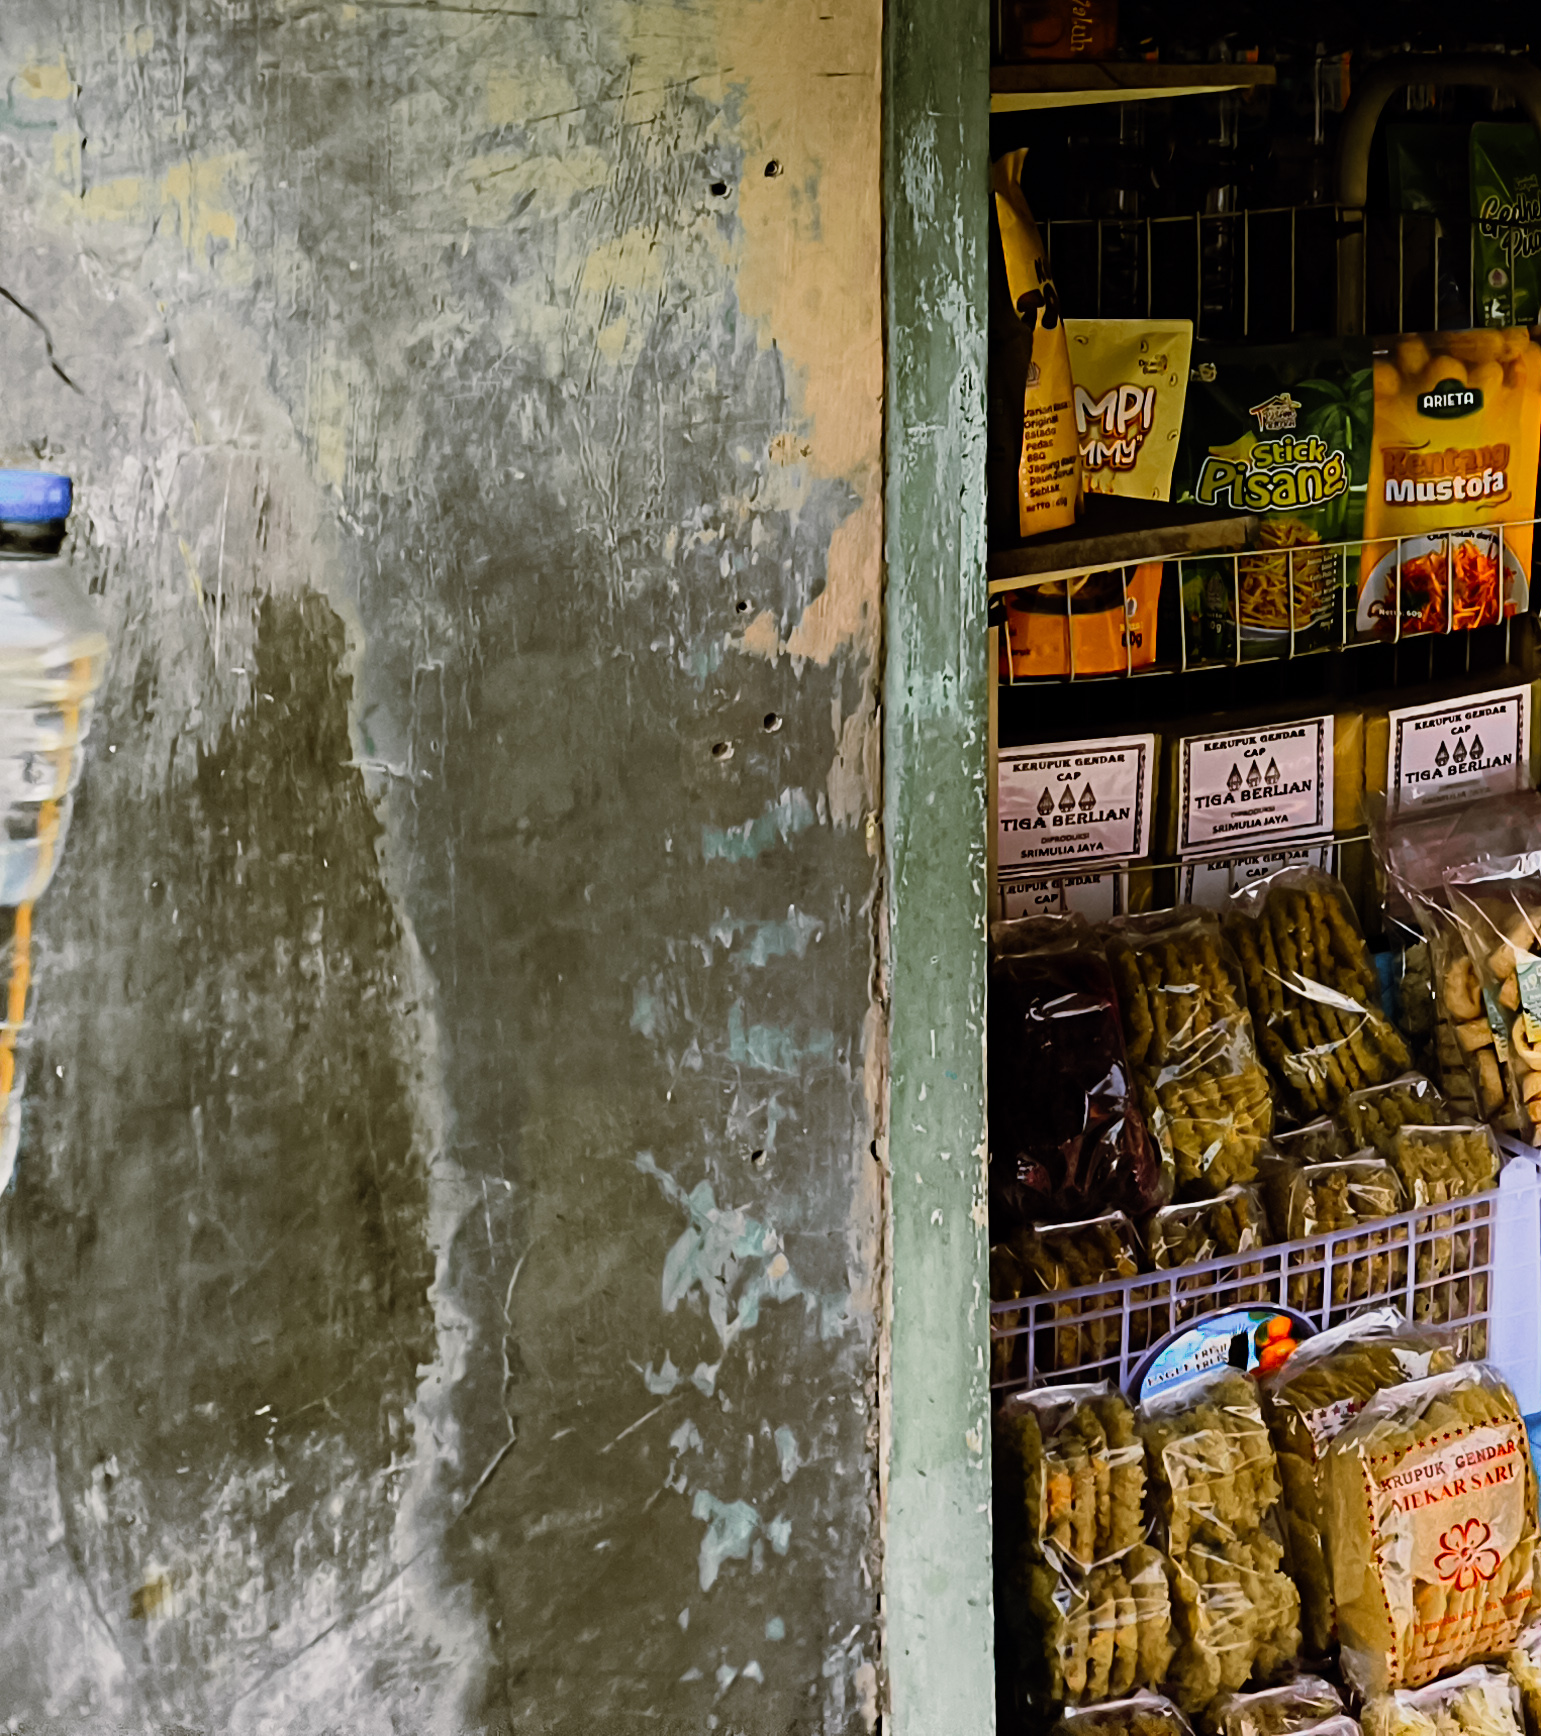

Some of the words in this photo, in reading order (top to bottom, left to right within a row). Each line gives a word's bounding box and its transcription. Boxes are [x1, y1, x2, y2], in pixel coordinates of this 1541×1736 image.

[1074, 384, 1156, 433] MPI
[1423, 392, 1474, 408] ARIETA
[1252, 436, 1326, 470] Stick
[1197, 450, 1348, 511] Pisang
[1385, 468, 1505, 503] Mustofa
[1414, 714, 1463, 731] KERUPUK
[1465, 706, 1507, 720] GENDAR
[1451, 724, 1472, 735] CAP
[1204, 736, 1258, 752] KERUPUK
[1260, 728, 1306, 744] GENDAR
[1243, 747, 1266, 758] CAP
[1013, 760, 1072, 773] KERUPUK
[1074, 754, 1126, 766] GENDAR
[1405, 767, 1443, 784] TIGA
[1447, 753, 1513, 777] BERLIAN
[1057, 772, 1082, 782] CAP
[1195, 794, 1236, 809] TIGA
[1240, 779, 1312, 803] BERLIAN
[1001, 817, 1047, 832] TIGA
[1052, 807, 1131, 827] BERLIAN
[1212, 818, 1262, 835] SRIMULIA
[1263, 814, 1289, 827] JAYA
[1020, 846, 1075, 859] SRIMULIA
[1076, 841, 1104, 854] JAYA
[1246, 866, 1269, 878] CAP
[1380, 1461, 1446, 1493] KRUPUK
[1455, 1439, 1517, 1469] GENDAR
[1391, 1477, 1468, 1514] MEKAR
[1471, 1462, 1515, 1491] SARI
